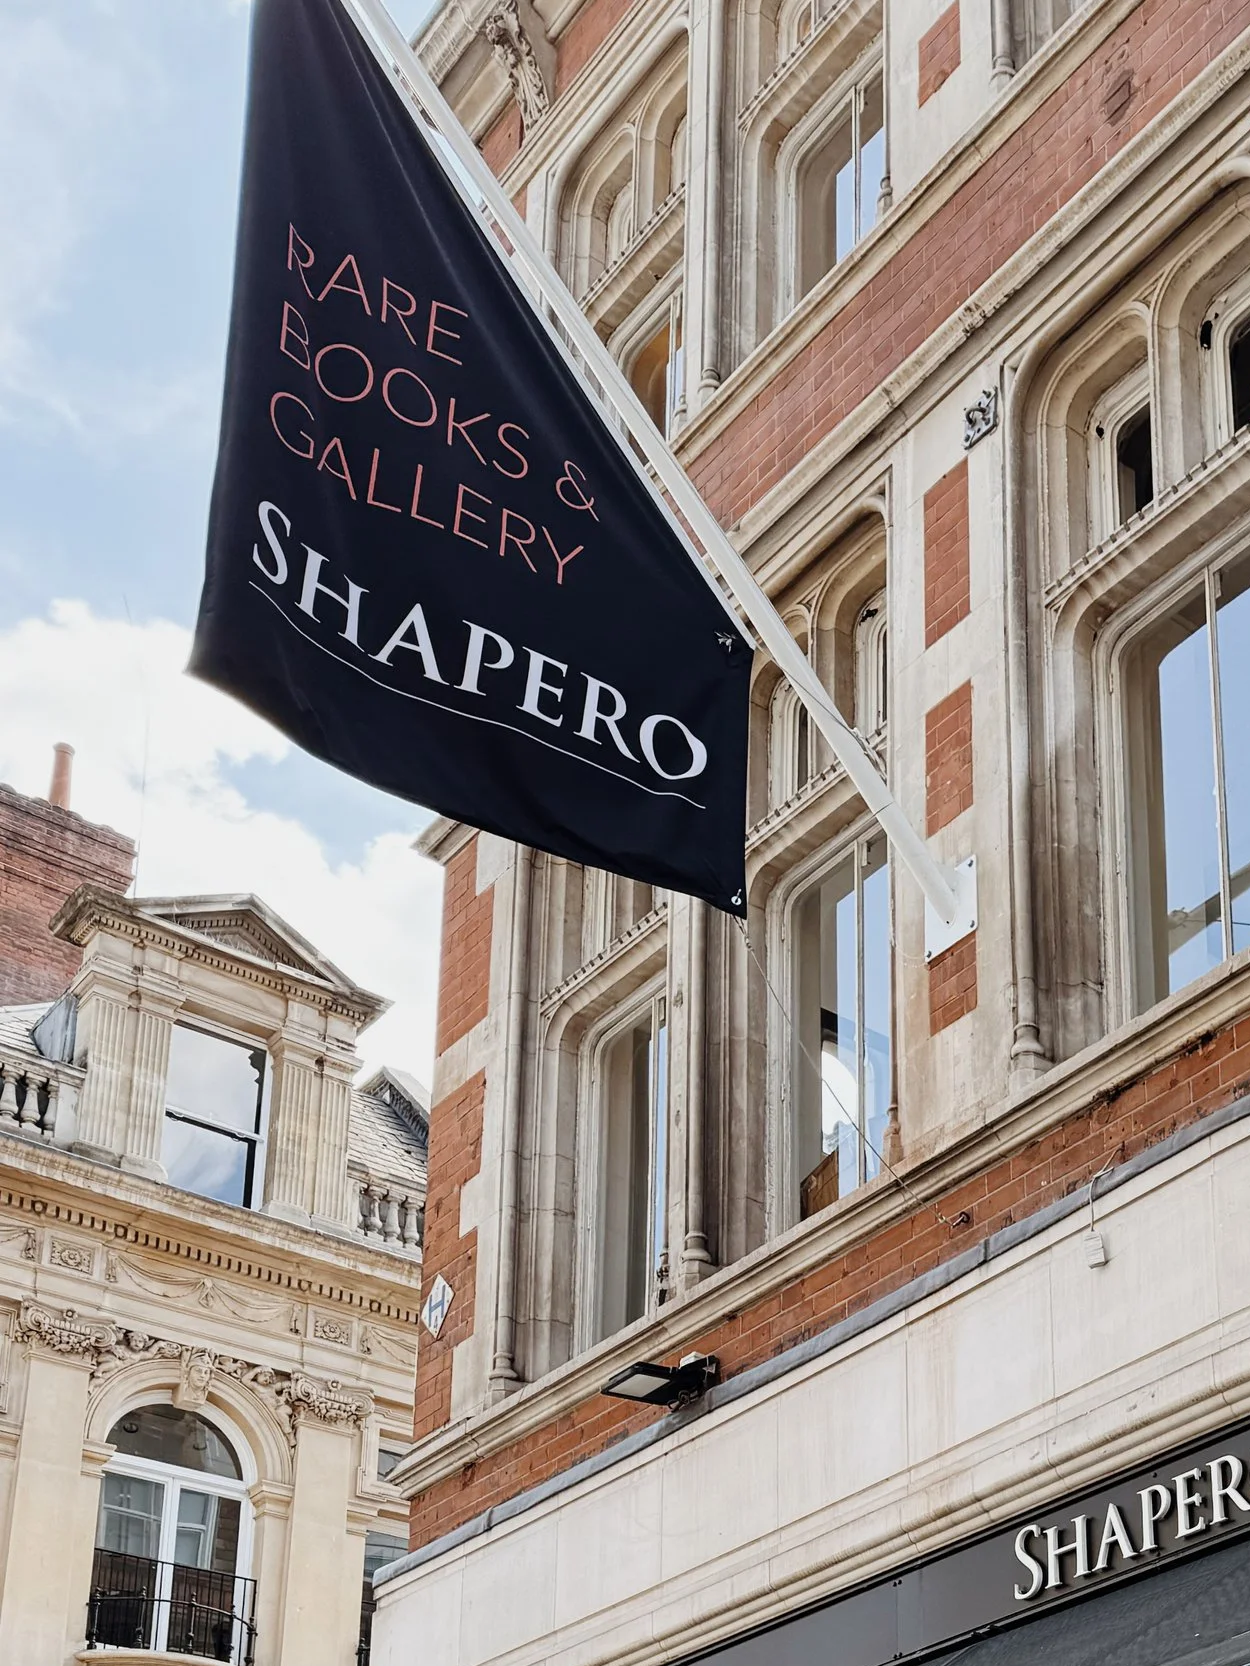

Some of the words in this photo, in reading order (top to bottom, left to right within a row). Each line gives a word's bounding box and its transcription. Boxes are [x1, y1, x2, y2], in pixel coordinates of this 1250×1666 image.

[287, 222, 469, 365] RARE
[270, 391, 584, 585] GALLERY
[280, 301, 530, 479] BOOKS
[555, 460, 600, 522] &
[252, 501, 707, 780] SHAPERO
